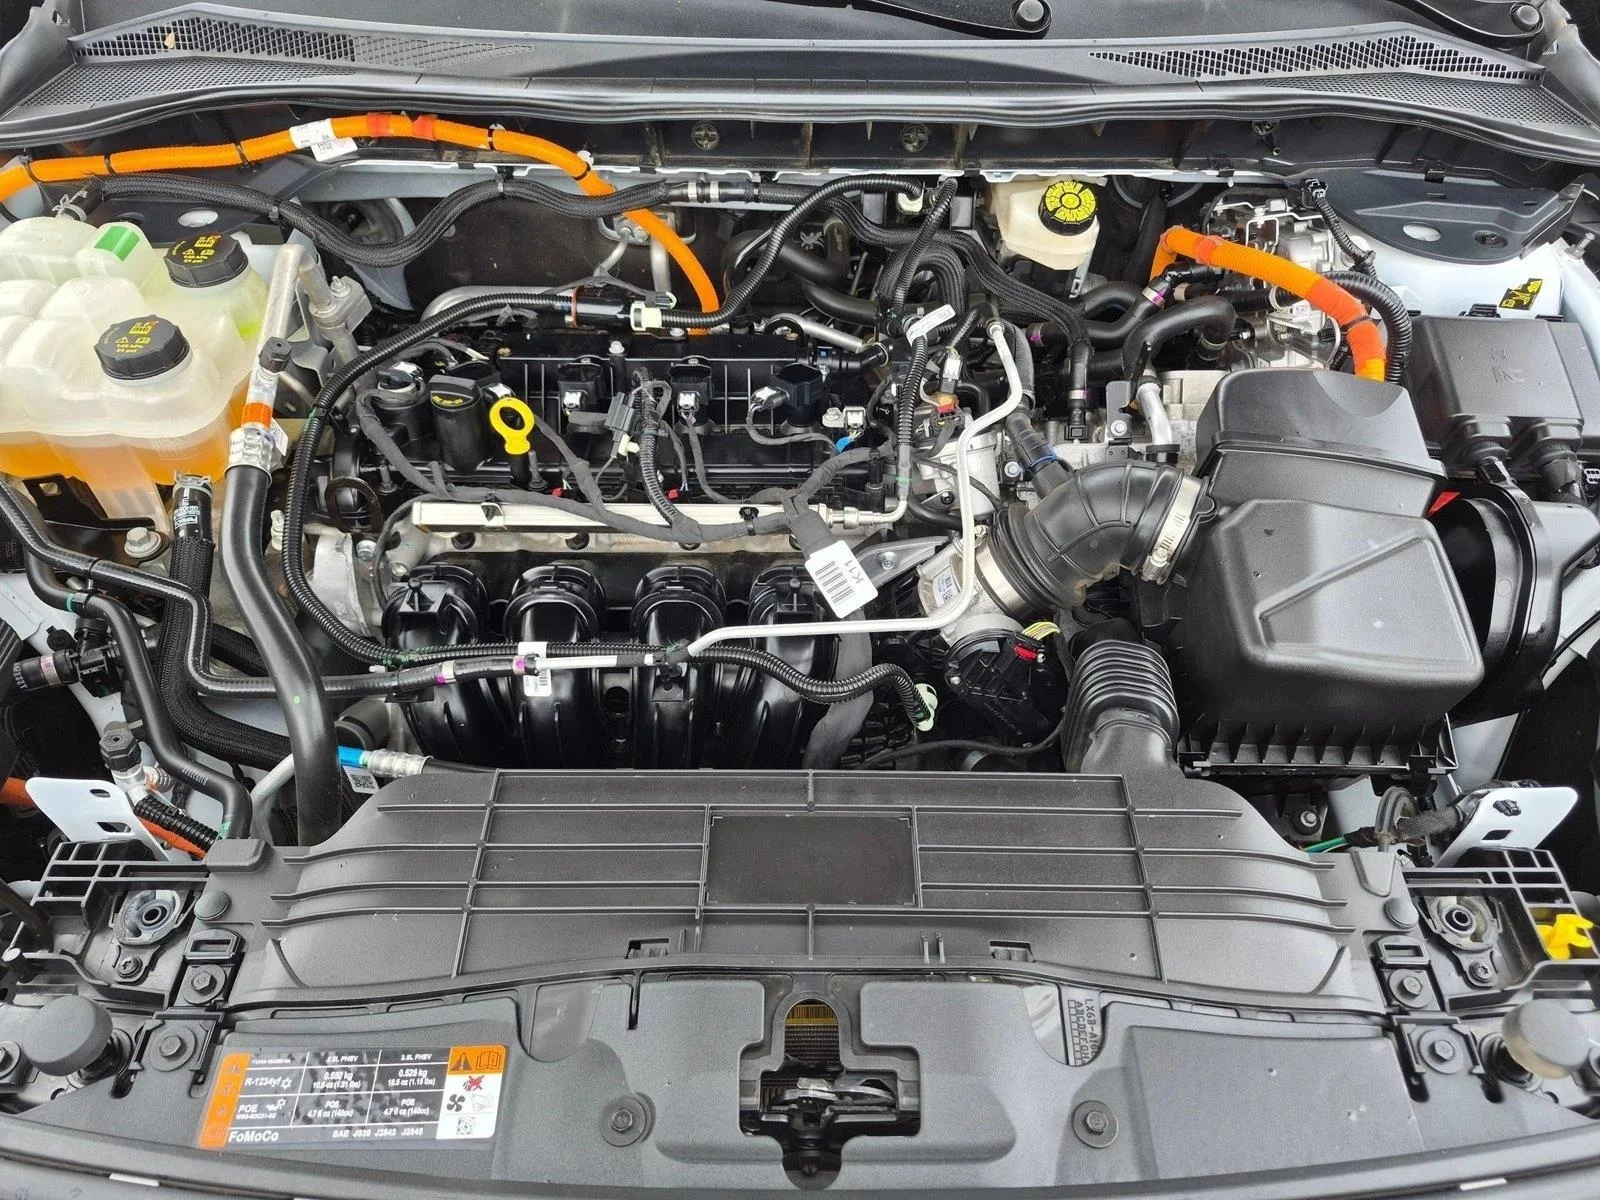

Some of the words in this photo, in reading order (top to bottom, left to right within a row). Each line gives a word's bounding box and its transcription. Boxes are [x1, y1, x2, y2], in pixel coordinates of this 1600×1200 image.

[843, 559, 865, 584] K11
[343, 1071, 354, 1082] kg
[418, 1068, 428, 1078] kg
[244, 1077, 282, 1088] R-1234yf
[401, 1098, 416, 1107] POE
[237, 1104, 259, 1114] POE
[228, 1129, 279, 1143] FoMoCo
[331, 1129, 350, 1139] SAE
